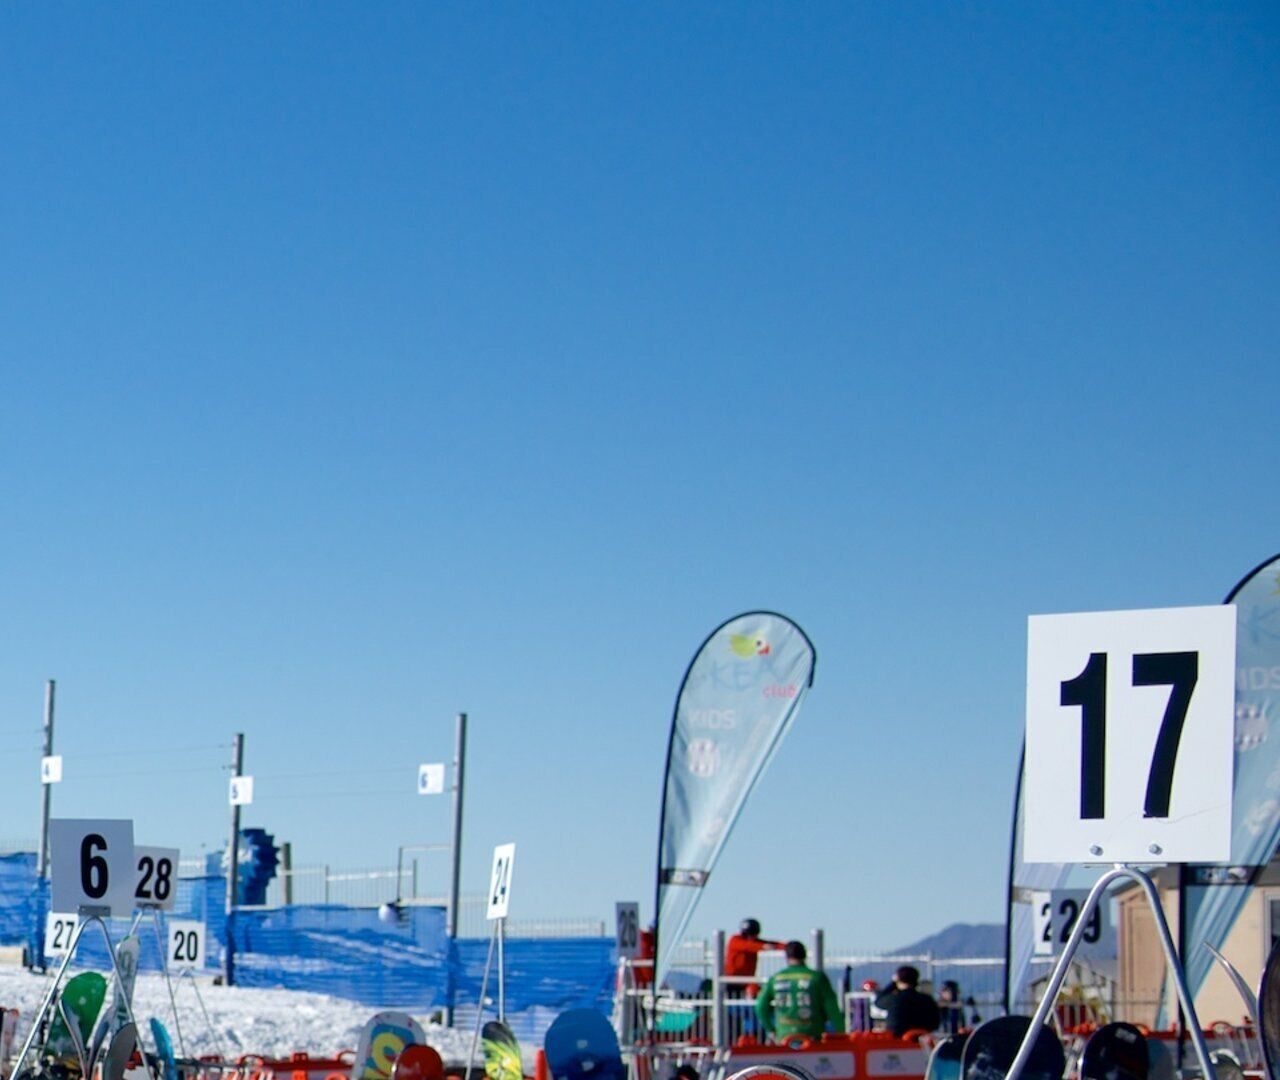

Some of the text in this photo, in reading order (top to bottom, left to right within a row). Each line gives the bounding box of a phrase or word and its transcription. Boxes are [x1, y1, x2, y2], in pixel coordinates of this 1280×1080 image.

[763, 684, 797, 698] club
[1060, 651, 1199, 820] 17
[80, 833, 109, 899] 6
[135, 856, 172, 900] 28
[52, 919, 76, 950] 27
[174, 929, 199, 963] 20
[617, 909, 637, 949] 26
